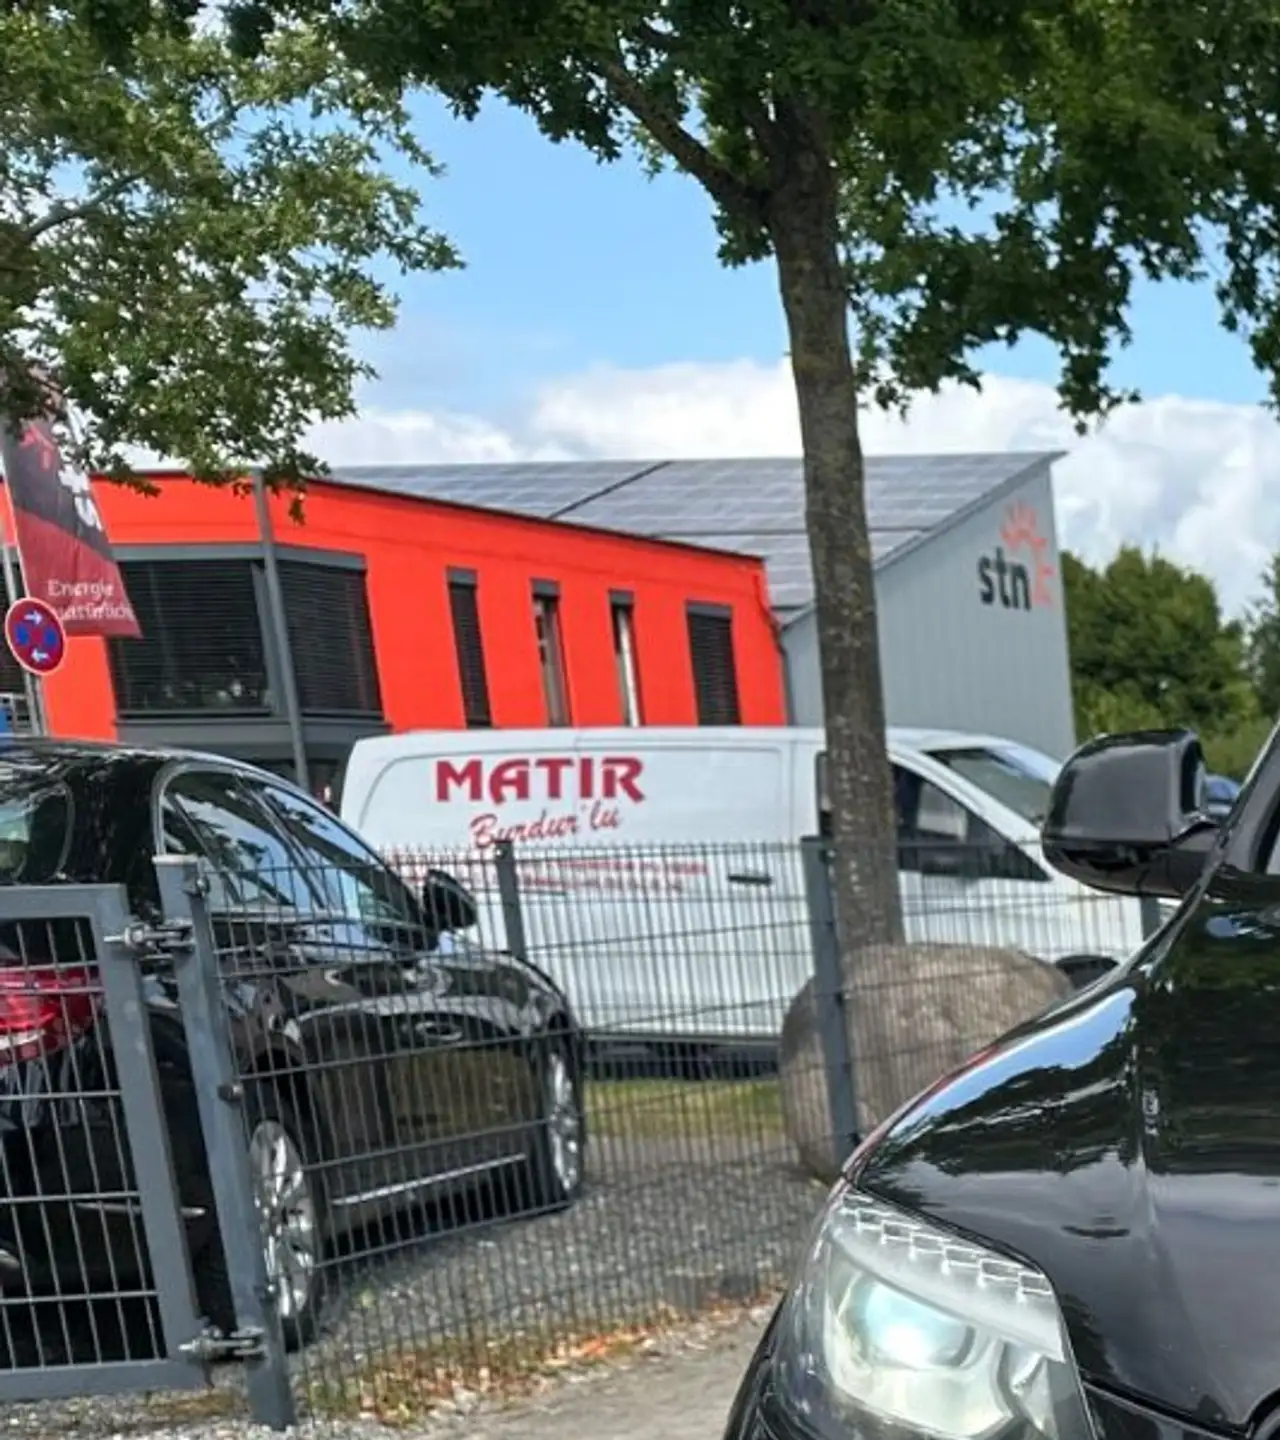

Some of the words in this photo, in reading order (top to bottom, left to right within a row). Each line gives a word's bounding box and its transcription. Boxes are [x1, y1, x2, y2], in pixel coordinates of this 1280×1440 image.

[47, 578, 115, 601] Energie
[977, 546, 1032, 612] stn
[435, 756, 647, 805] MATIR
